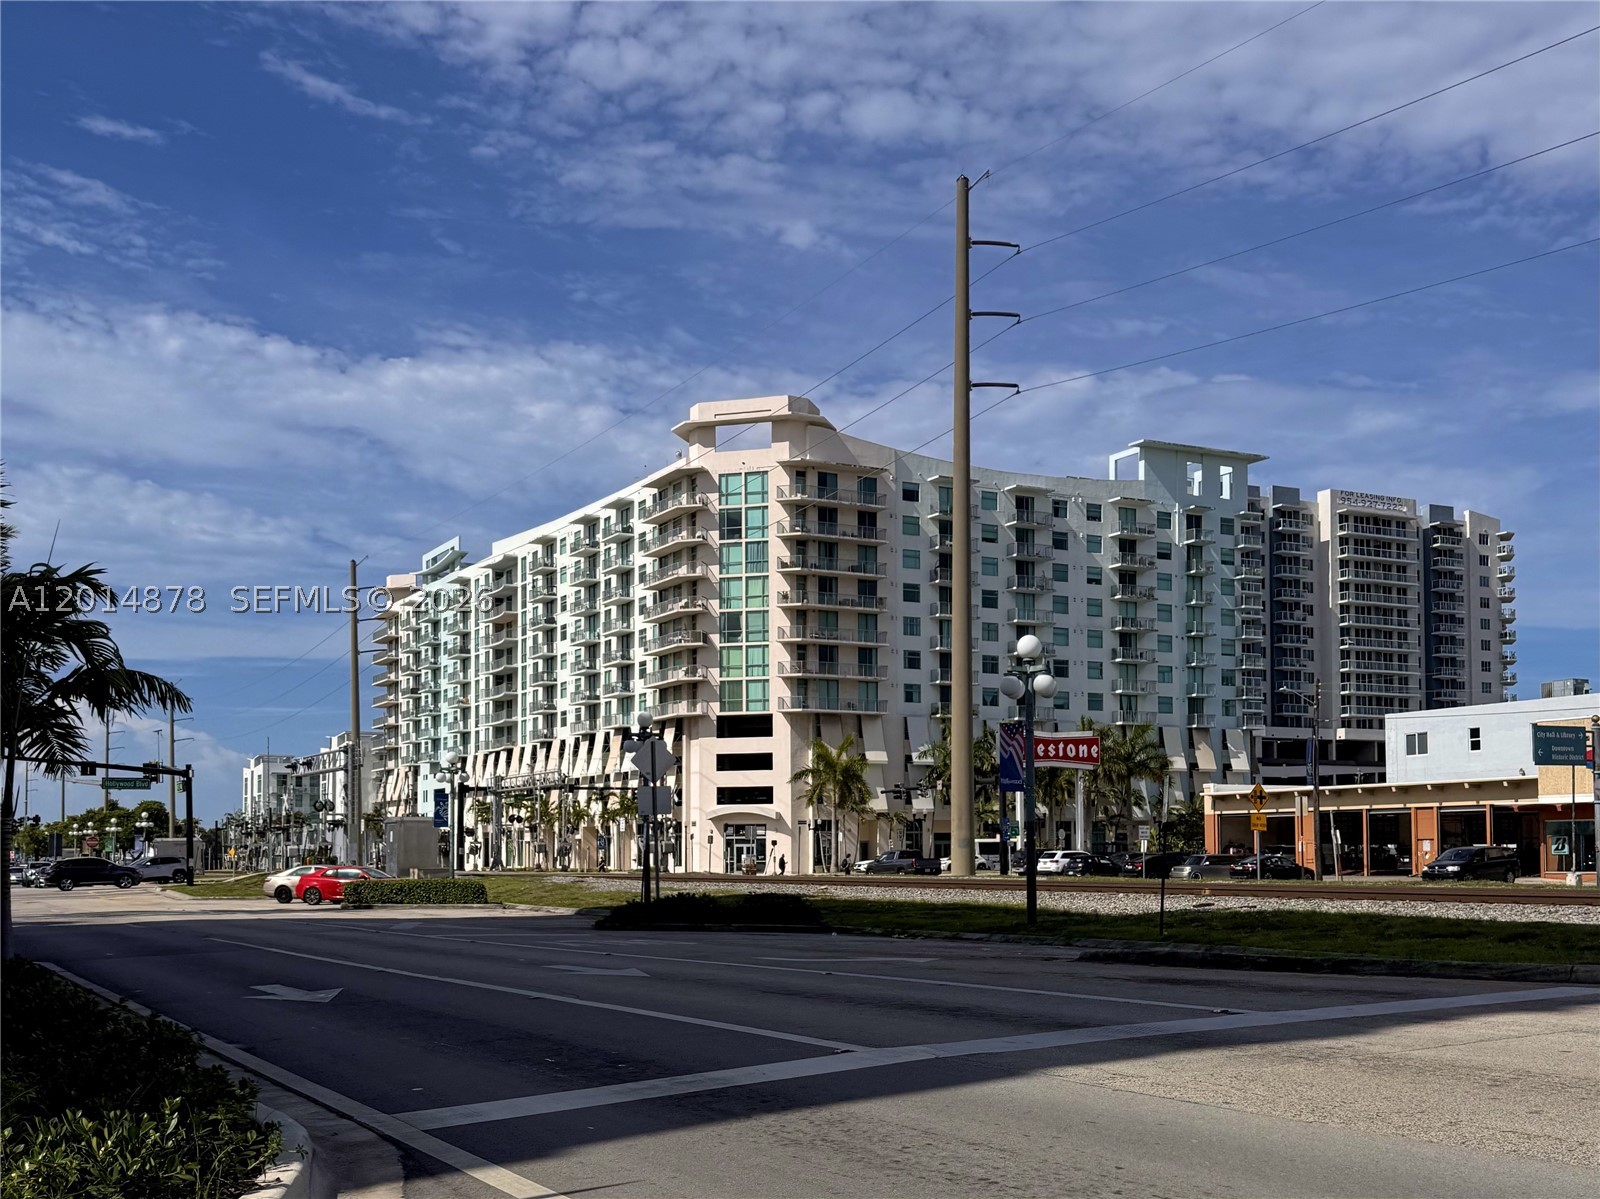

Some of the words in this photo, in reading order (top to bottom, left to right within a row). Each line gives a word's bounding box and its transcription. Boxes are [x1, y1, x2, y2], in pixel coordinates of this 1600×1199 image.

[1355, 492, 1385, 501] LEASING
[1340, 497, 1404, 510] 954-927-7222
[1536, 731, 1546, 739] City
[1560, 731, 1576, 740] Library
[1036, 741, 1099, 758] estone
[1569, 753, 1585, 761] District
[105, 780, 134, 788] Hollywood
